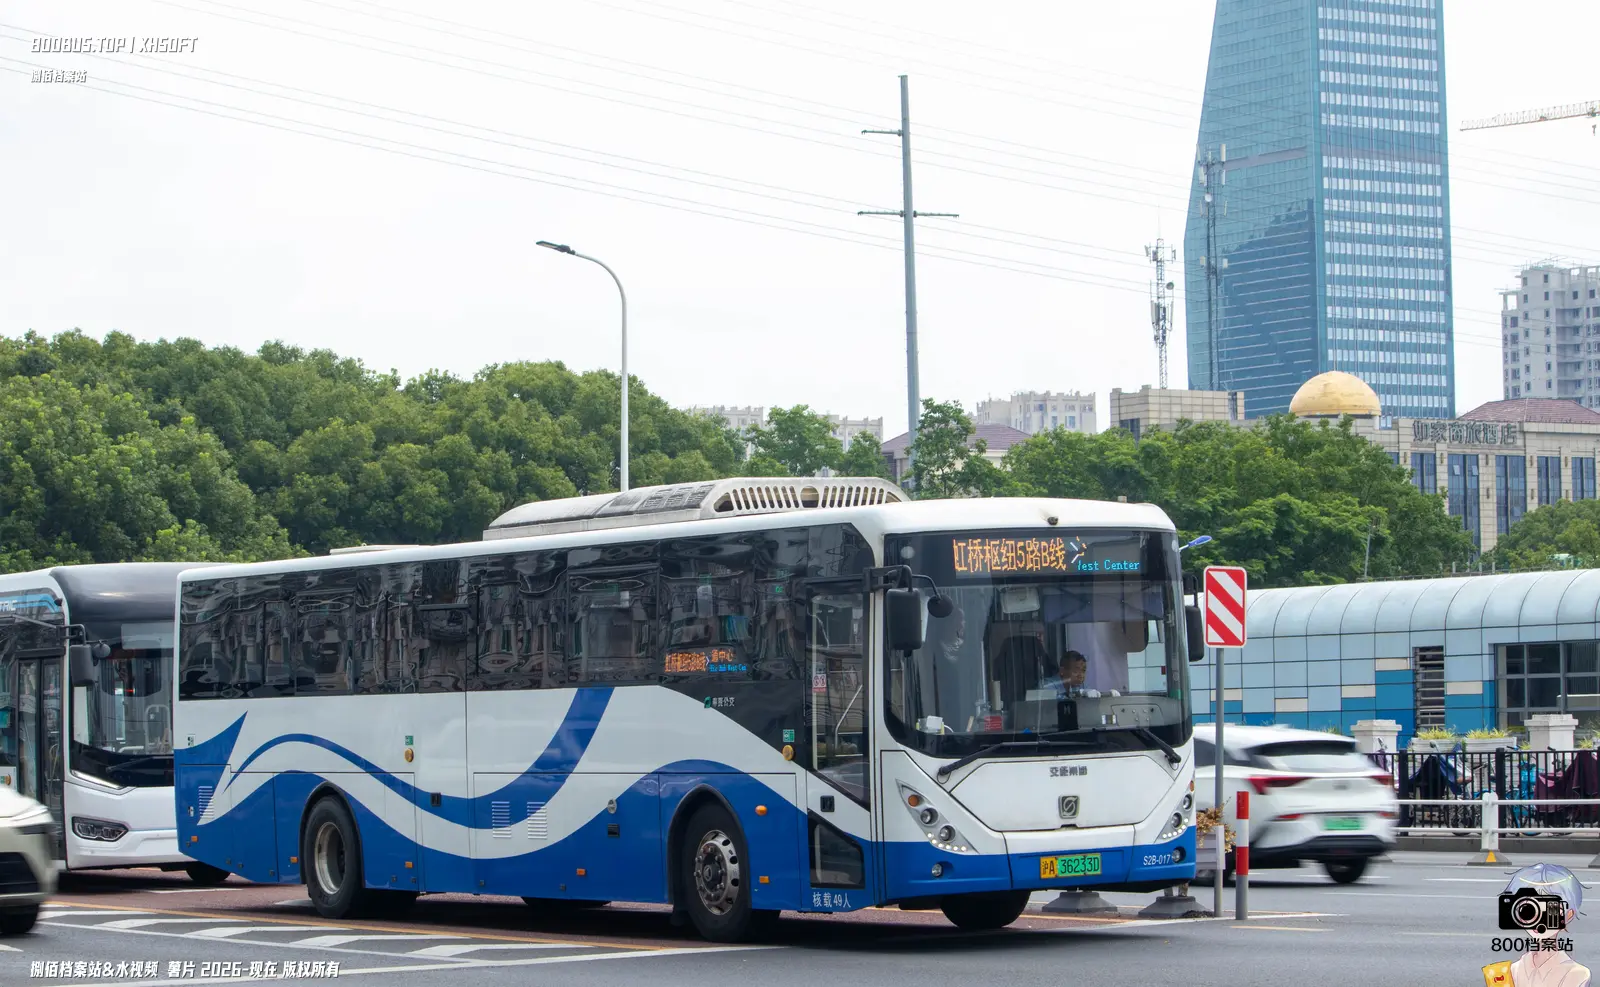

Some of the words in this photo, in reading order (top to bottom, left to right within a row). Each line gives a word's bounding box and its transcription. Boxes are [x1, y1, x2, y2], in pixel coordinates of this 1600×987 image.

[1413, 420, 1517, 445] 如家商旅酒店
[952, 537, 1067, 573] 虹桥枢纽5路B线
[1104, 558, 1140, 571] Center
[1143, 854, 1171, 866] S2B-017
